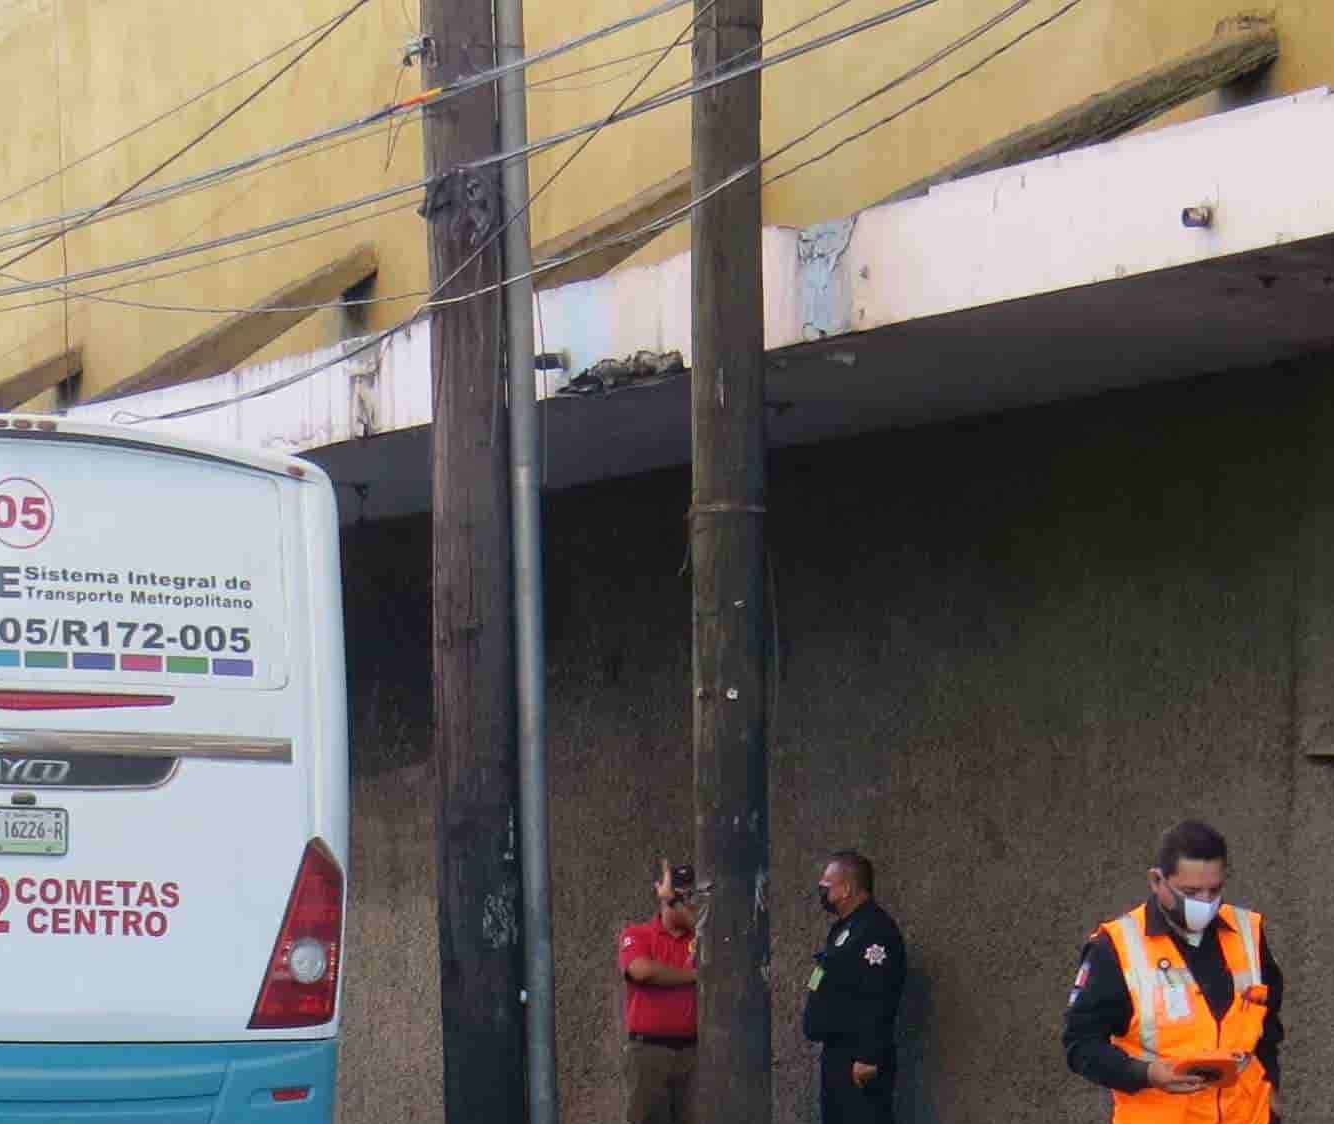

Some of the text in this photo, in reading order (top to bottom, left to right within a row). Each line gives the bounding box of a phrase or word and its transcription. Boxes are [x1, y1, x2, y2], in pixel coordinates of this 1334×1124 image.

[24, 566, 119, 585] Sistema
[127, 571, 217, 590] Integral
[224, 576, 252, 591] de
[26, 586, 254, 610] Transporte Metropolitano
[15, 877, 180, 908] COMETAS
[26, 907, 168, 937] CENTRO
